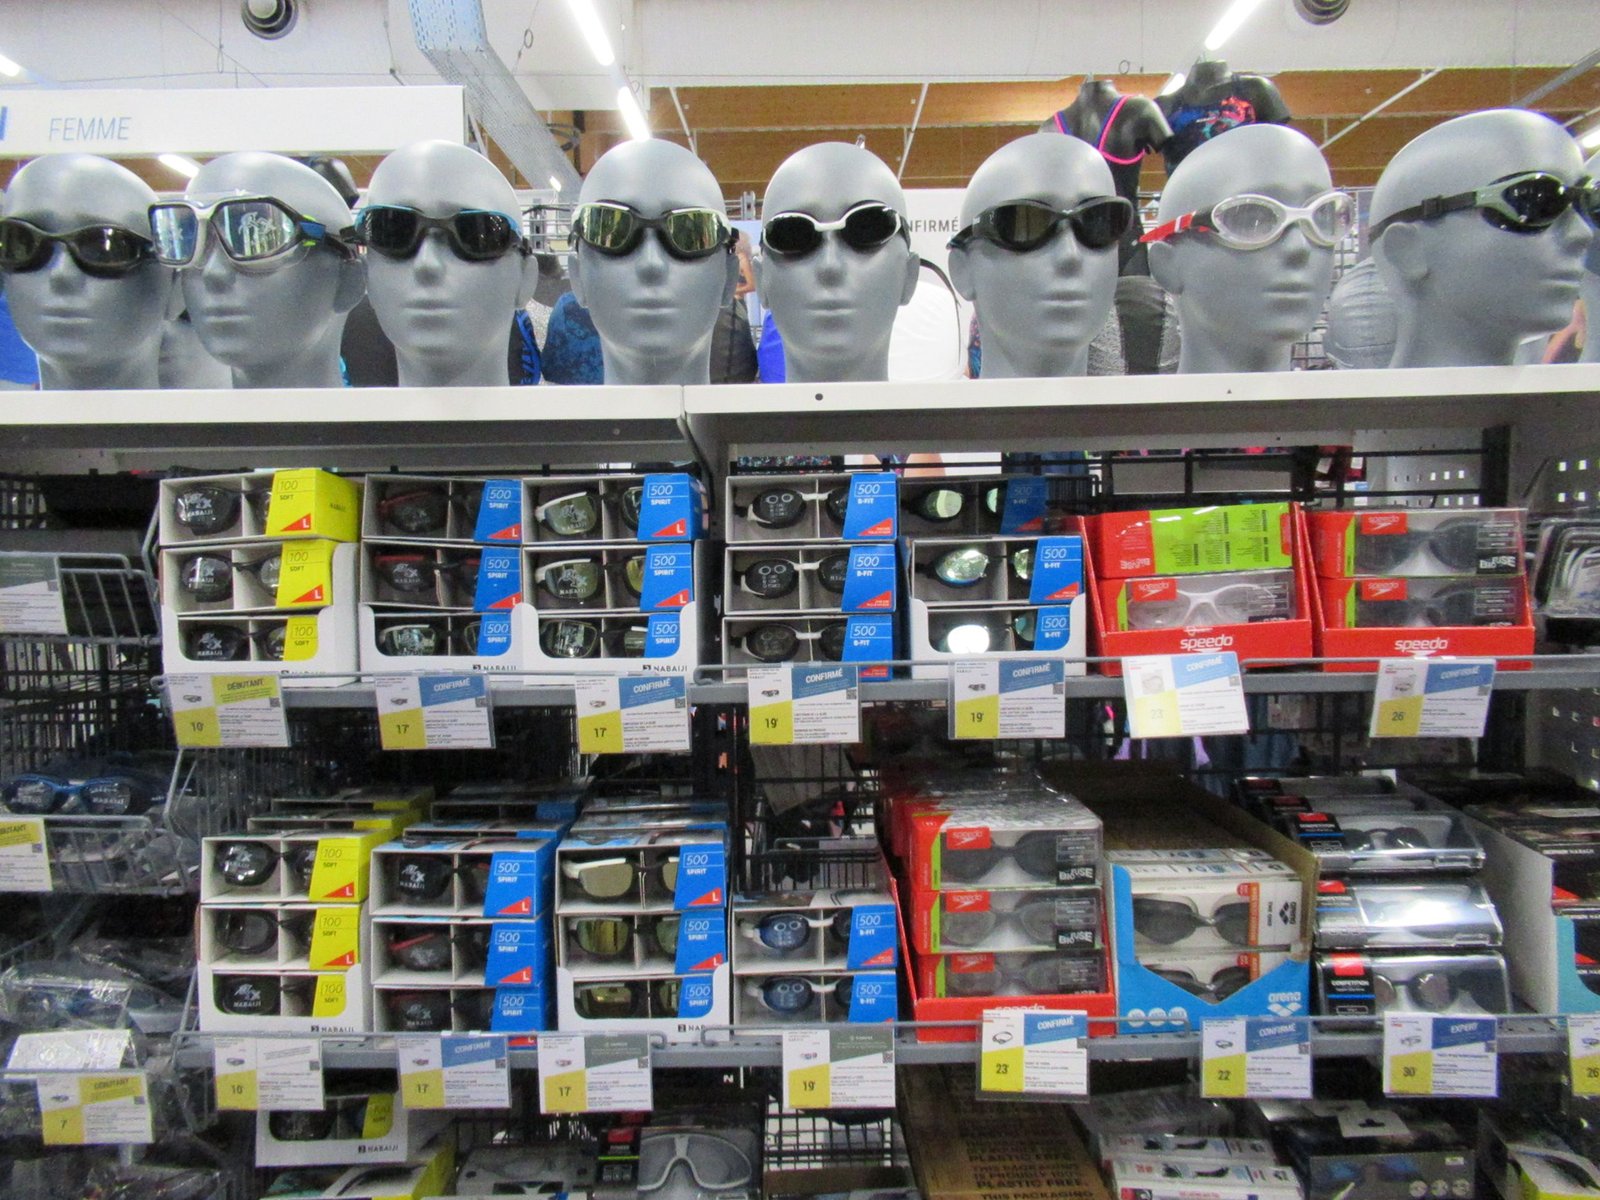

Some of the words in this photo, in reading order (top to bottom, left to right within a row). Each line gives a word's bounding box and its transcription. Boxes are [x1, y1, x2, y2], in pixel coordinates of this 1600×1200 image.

[49, 116, 132, 141] FEMME
[908, 217, 959, 232] NFIRMÉ
[279, 479, 299, 491] 100
[651, 485, 673, 496] 500
[857, 484, 881, 494] 500
[489, 489, 511, 500] 500
[302, 518, 310, 528] L
[676, 524, 684, 533] L
[511, 528, 518, 537] L
[289, 551, 308, 562] 100
[1043, 548, 1067, 559] 500
[488, 559, 510, 569] 500
[653, 556, 676, 566] 500
[856, 556, 880, 567] 500
[314, 589, 322, 599] L
[679, 594, 687, 604] L
[1043, 617, 1067, 628] 500
[294, 626, 313, 637] 100
[487, 623, 508, 634] 500
[655, 623, 678, 634] 500
[853, 625, 876, 636] 500
[1180, 634, 1234, 651] speedo
[1394, 637, 1449, 652] speedo
[805, 667, 843, 683] CONFIRMÉ
[633, 678, 671, 694] CONFIRMÉ
[322, 848, 342, 858] 100
[686, 854, 708, 865] 500
[497, 863, 520, 873] 500
[346, 886, 353, 896] L
[711, 892, 719, 901] L
[521, 902, 529, 911] L
[322, 916, 342, 927] 100
[687, 920, 710, 931] 500
[858, 915, 881, 926] 500
[497, 932, 520, 943] 500
[346, 954, 353, 964] L
[713, 956, 720, 966] L
[522, 971, 530, 981] L
[324, 983, 343, 994] 100
[689, 986, 711, 997] 500
[859, 984, 881, 995] 500
[502, 996, 525, 1006] 500
[1268, 991, 1302, 1003] arena
[1037, 1015, 1074, 1031] CONFIRMÉ
[1451, 1022, 1479, 1034] EXPERT
[1217, 1069, 1232, 1081] 22
